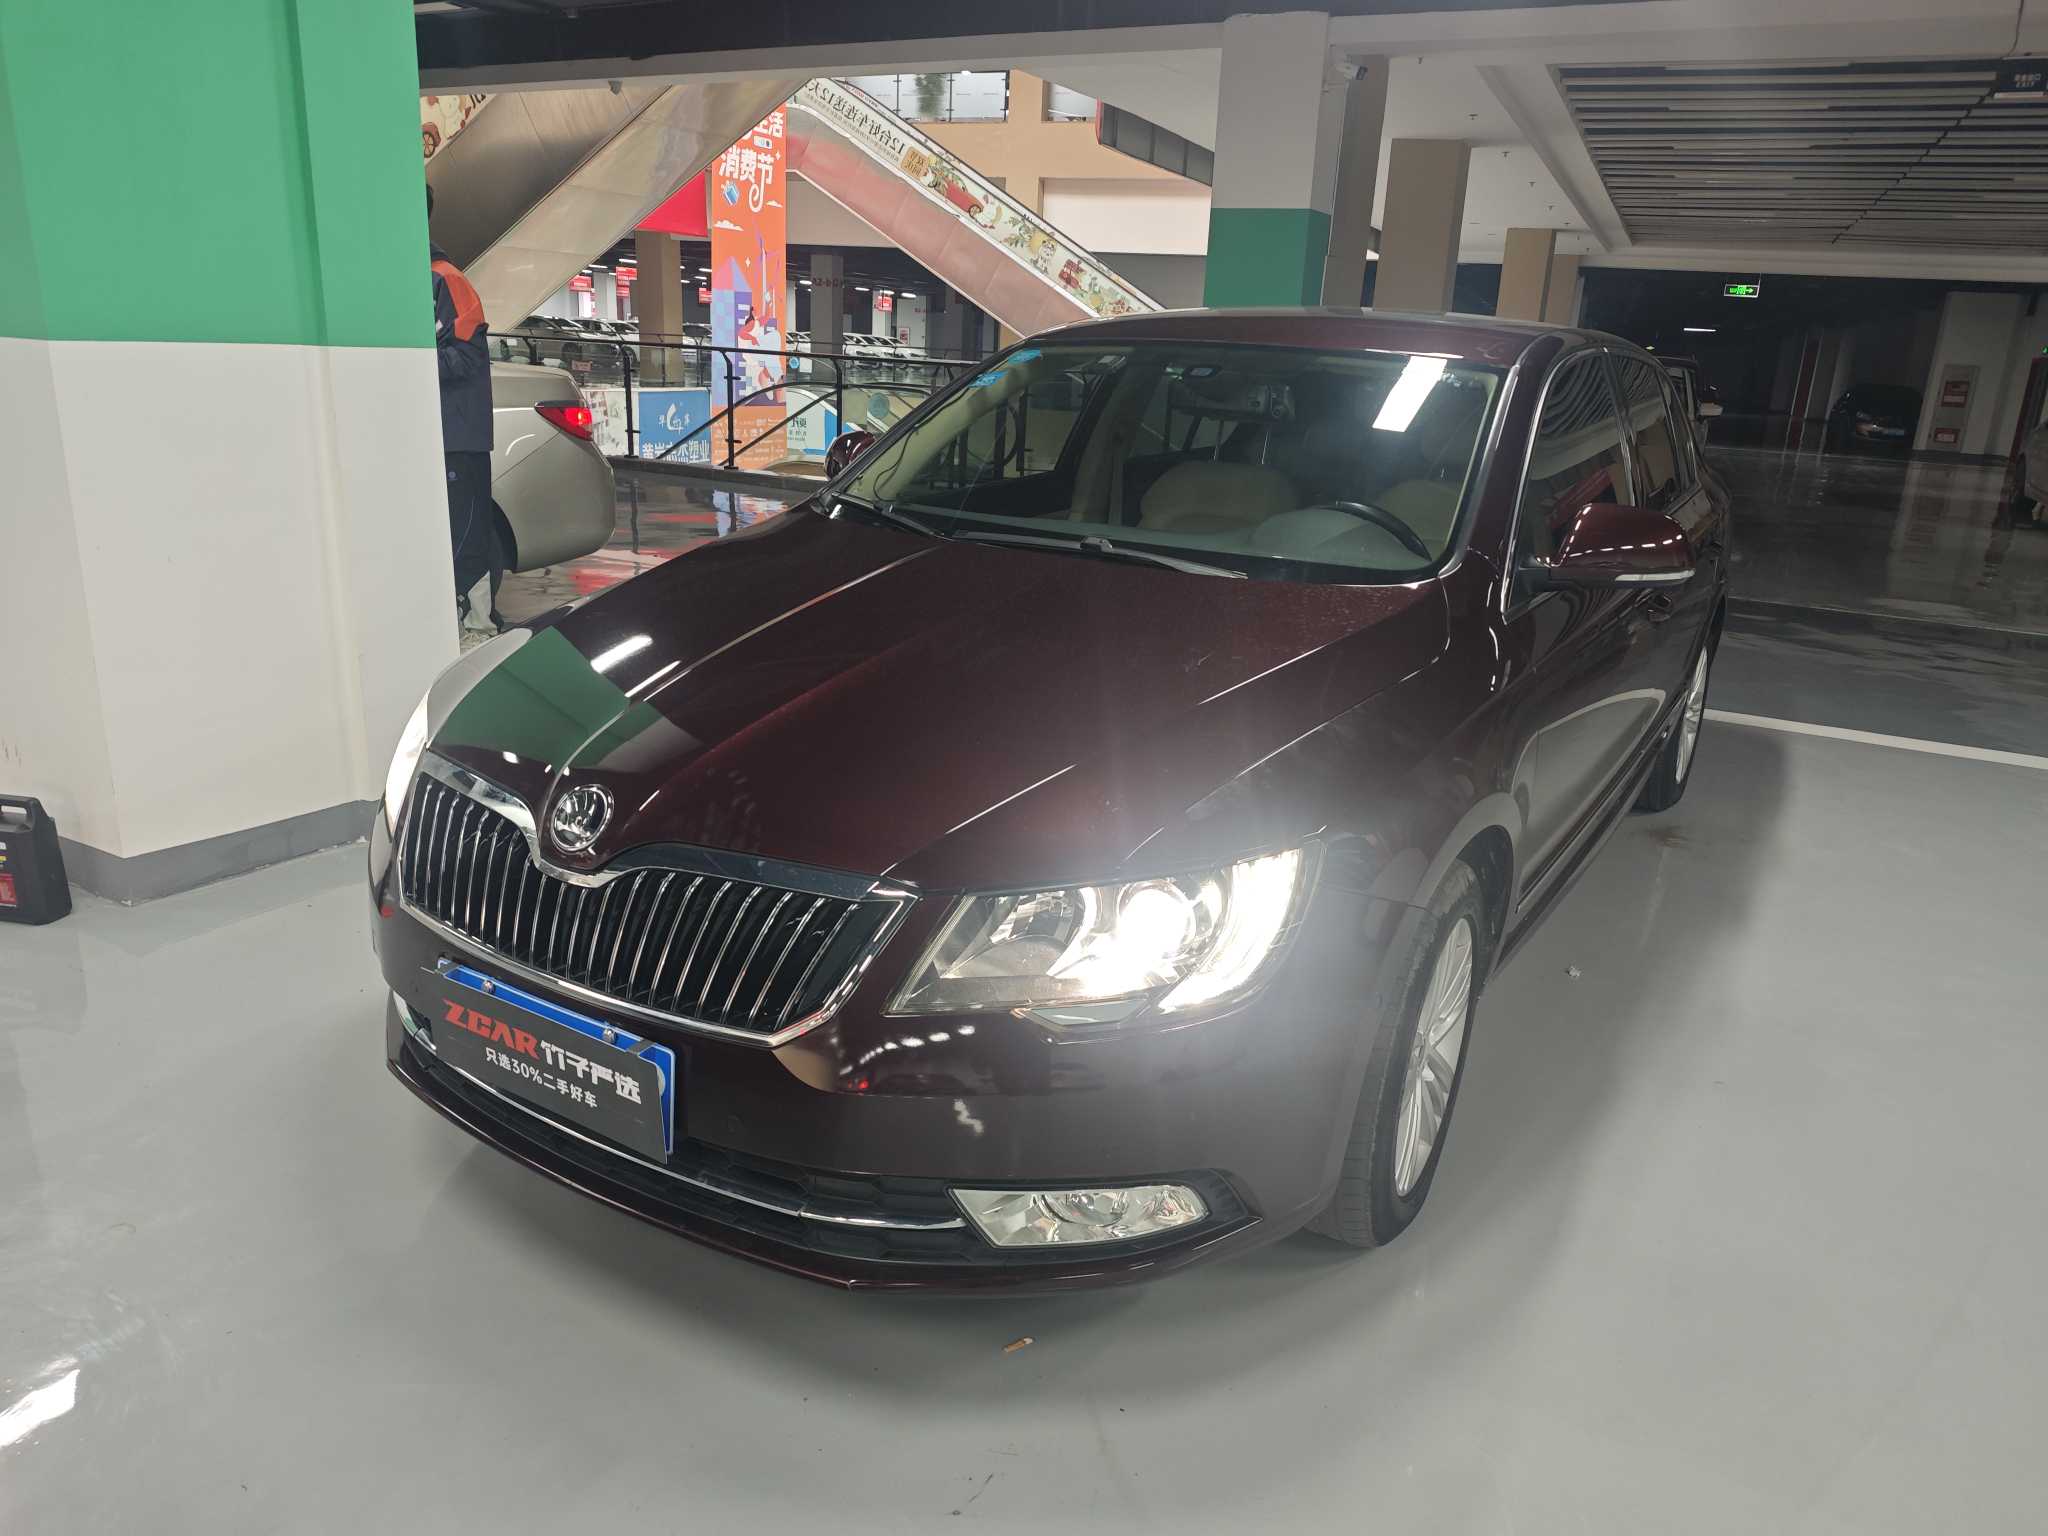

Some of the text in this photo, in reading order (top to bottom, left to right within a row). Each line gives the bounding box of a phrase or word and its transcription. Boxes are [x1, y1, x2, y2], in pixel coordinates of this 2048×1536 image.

[719, 144, 775, 212] 消费节
[485, 1047, 598, 1109] 只选30%二手好车
[540, 1039, 642, 1105] 竹子严选
